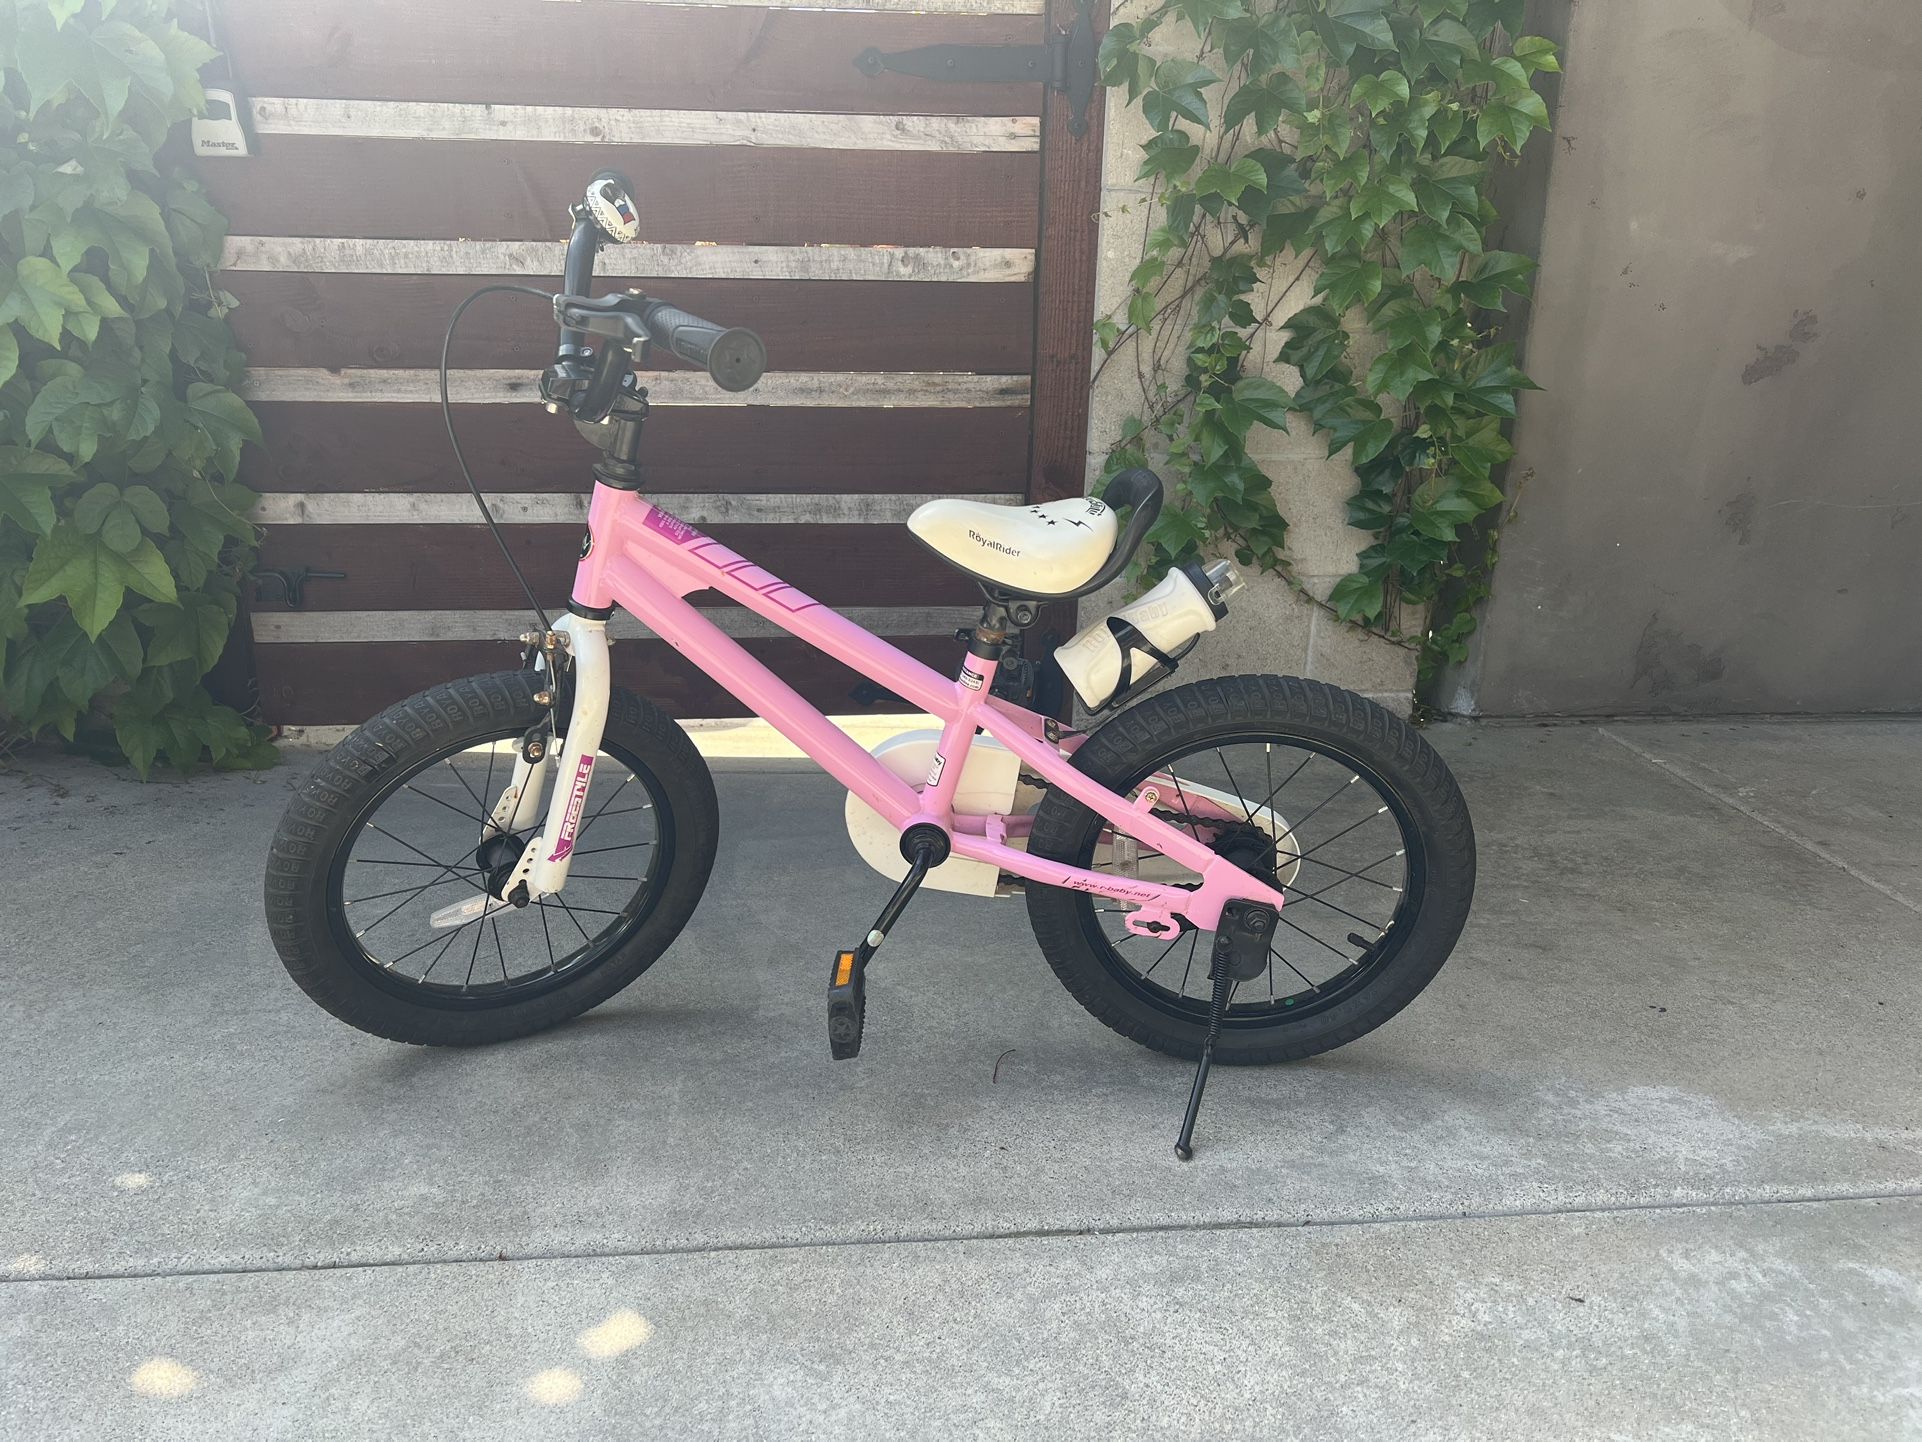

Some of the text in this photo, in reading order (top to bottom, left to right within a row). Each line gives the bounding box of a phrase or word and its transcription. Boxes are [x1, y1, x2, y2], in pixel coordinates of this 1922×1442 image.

[201, 140, 236, 148] Master
[968, 529, 1021, 557] RoyalRider
[560, 763, 591, 841] FREESTYLE
